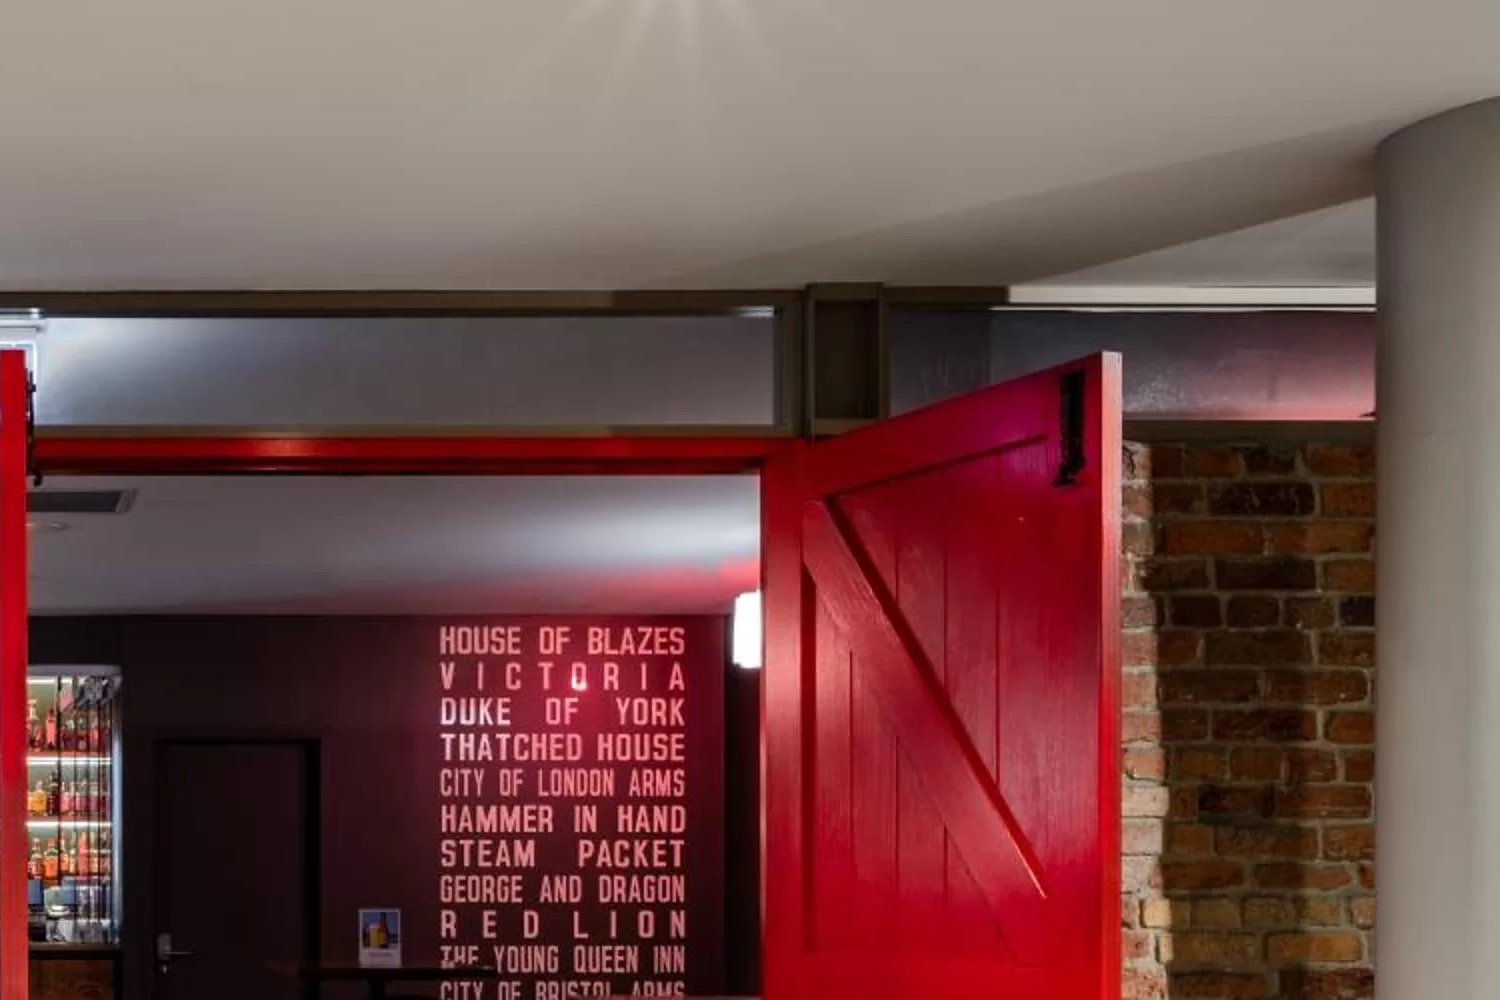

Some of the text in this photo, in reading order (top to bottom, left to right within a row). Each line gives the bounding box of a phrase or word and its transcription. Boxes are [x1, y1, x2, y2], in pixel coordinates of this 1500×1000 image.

[439, 626, 685, 655] HOUSE OF BLAZES
[439, 661, 685, 692] VICTORIA
[440, 697, 685, 726] DUKE OF YORK
[440, 733, 685, 761] THATCHED HOUSE
[440, 768, 685, 797] CITY OF LONDON ARMS
[441, 804, 686, 833] HAMMER IN HAND
[441, 839, 685, 867] STEAM PACKET
[440, 875, 685, 903] GEORGE AND DRAGON
[441, 910, 685, 938] RED LION
[493, 945, 559, 973] YOUNG
[574, 945, 638, 973] QUEEN
[653, 945, 685, 973] INN
